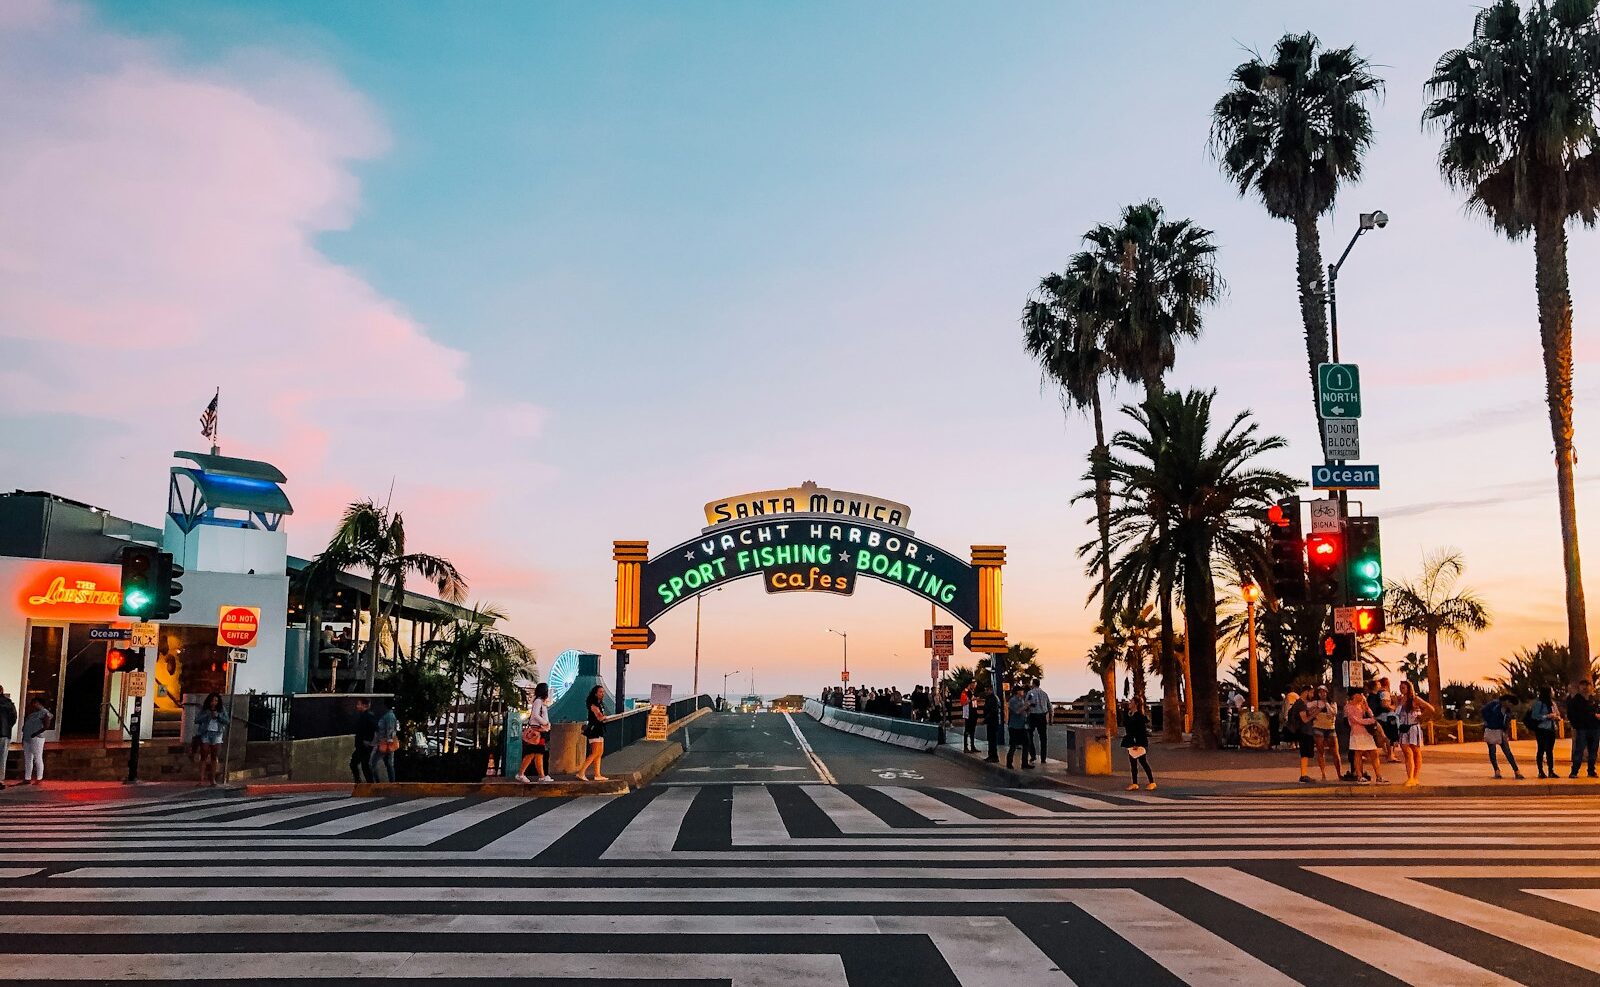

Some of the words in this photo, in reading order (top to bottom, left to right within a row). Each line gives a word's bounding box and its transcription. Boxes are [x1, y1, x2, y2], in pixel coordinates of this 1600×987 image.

[1336, 373, 1342, 386] 1
[1322, 392, 1358, 403] NORTH
[1327, 424, 1339, 434] DO
[1341, 424, 1356, 434] NOT
[1328, 437, 1357, 447] BLOCK
[1316, 467, 1375, 482] Ocean
[714, 497, 795, 524] SANTA
[809, 494, 902, 526] MONICA
[701, 524, 789, 555] YACHT
[810, 524, 919, 559] HARBOR
[657, 557, 727, 604] SPORT
[737, 544, 832, 571] FISHING
[856, 549, 957, 603] BOATING
[771, 567, 848, 590] cafes
[75, 580, 96, 590] THE
[226, 614, 237, 622] DO
[1335, 620, 1345, 631] OK
[90, 629, 120, 638] Ocean
[226, 631, 249, 639] ENTER
[132, 635, 143, 645] OK
